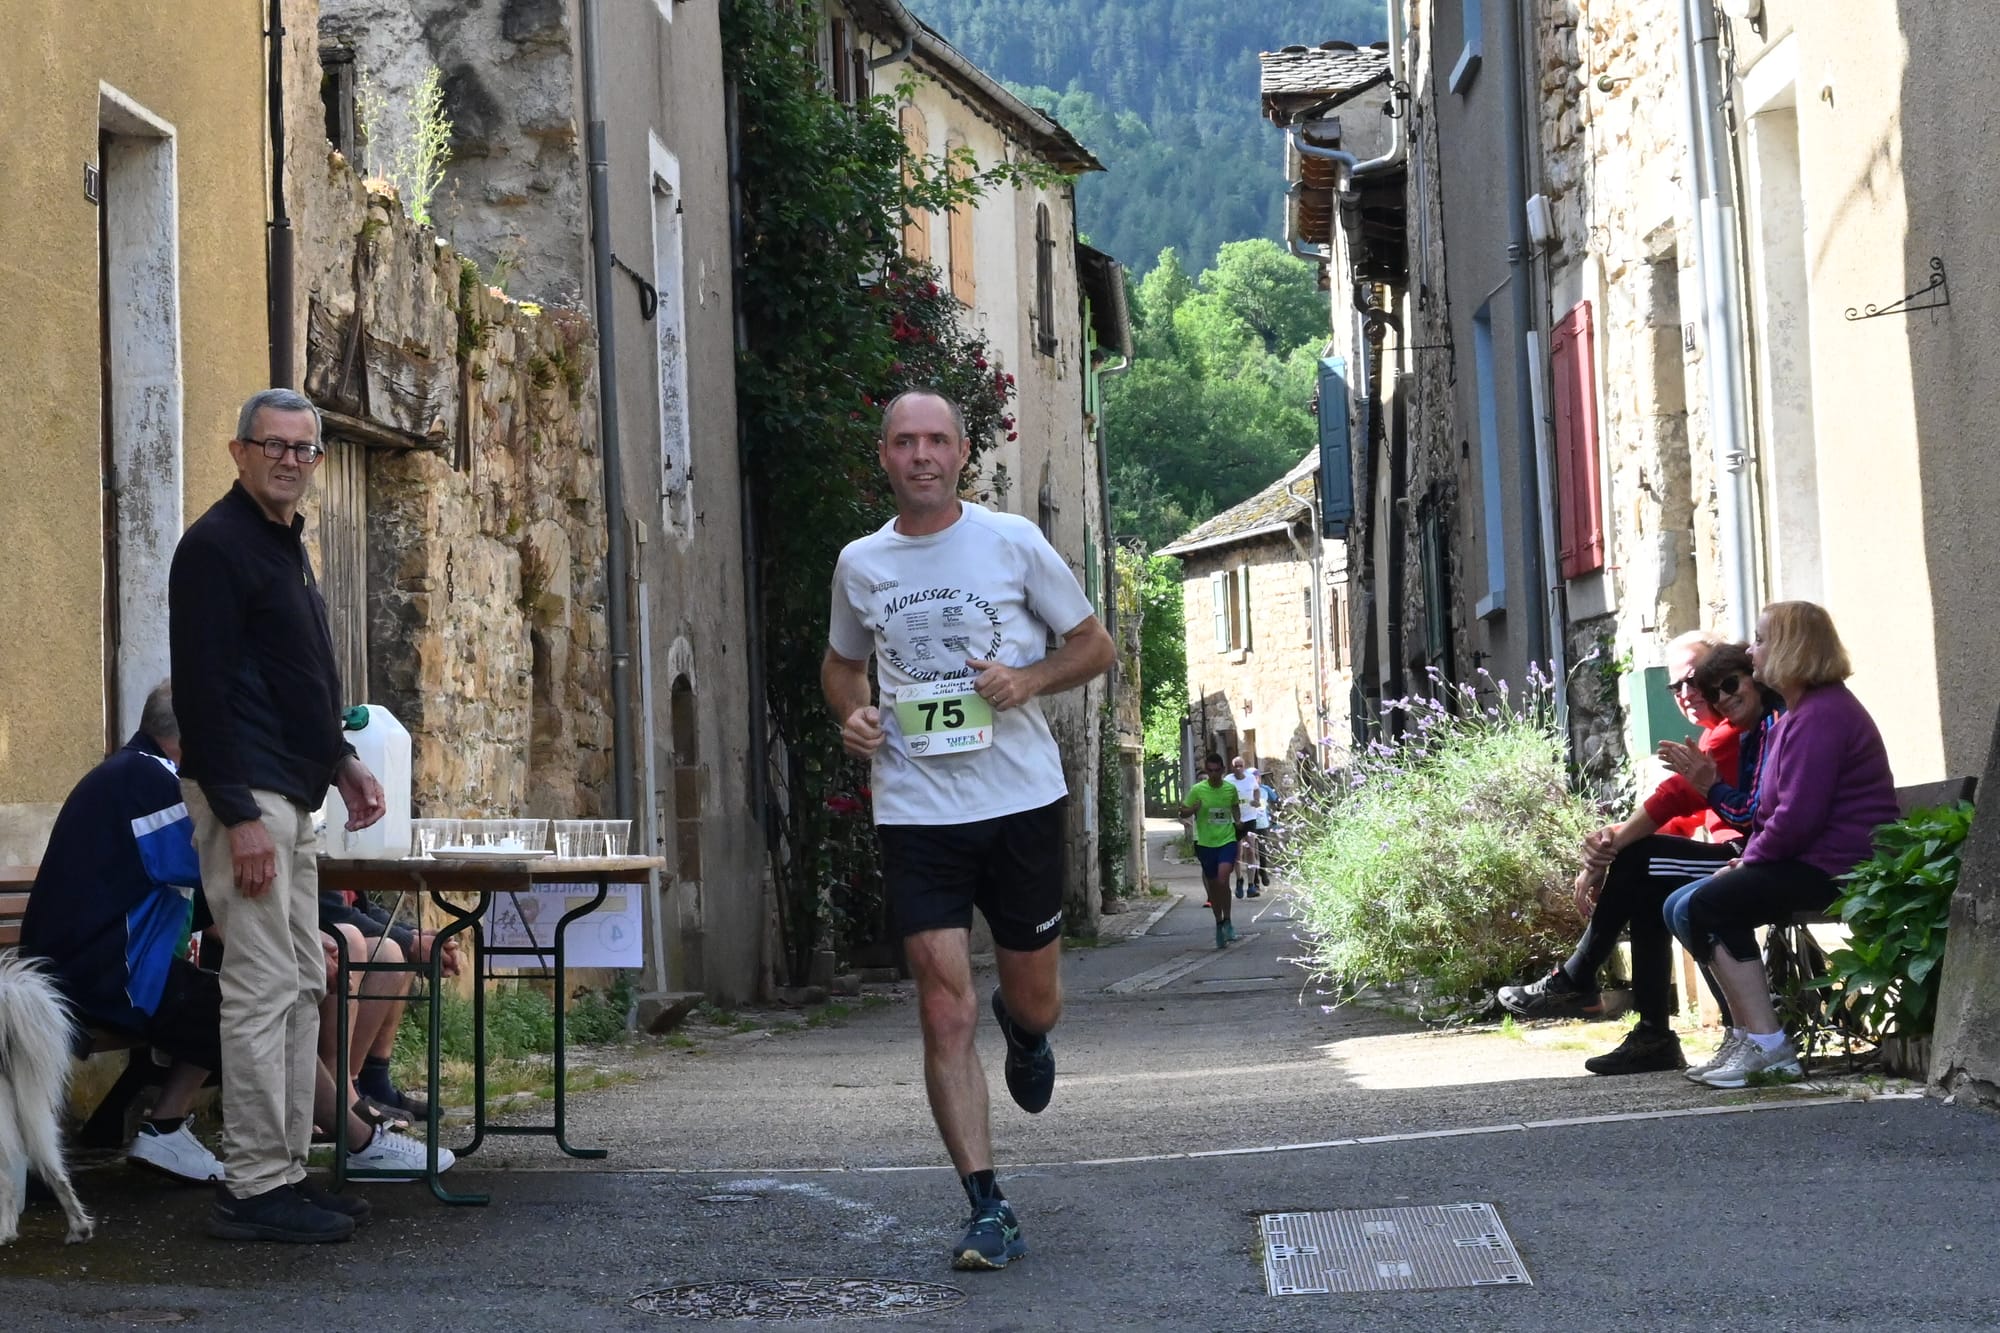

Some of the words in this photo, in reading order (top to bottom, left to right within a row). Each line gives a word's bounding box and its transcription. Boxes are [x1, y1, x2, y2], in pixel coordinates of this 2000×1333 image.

[884, 588, 961, 622] Moussac
[908, 665, 941, 681] tout
[918, 699, 965, 731] 75
